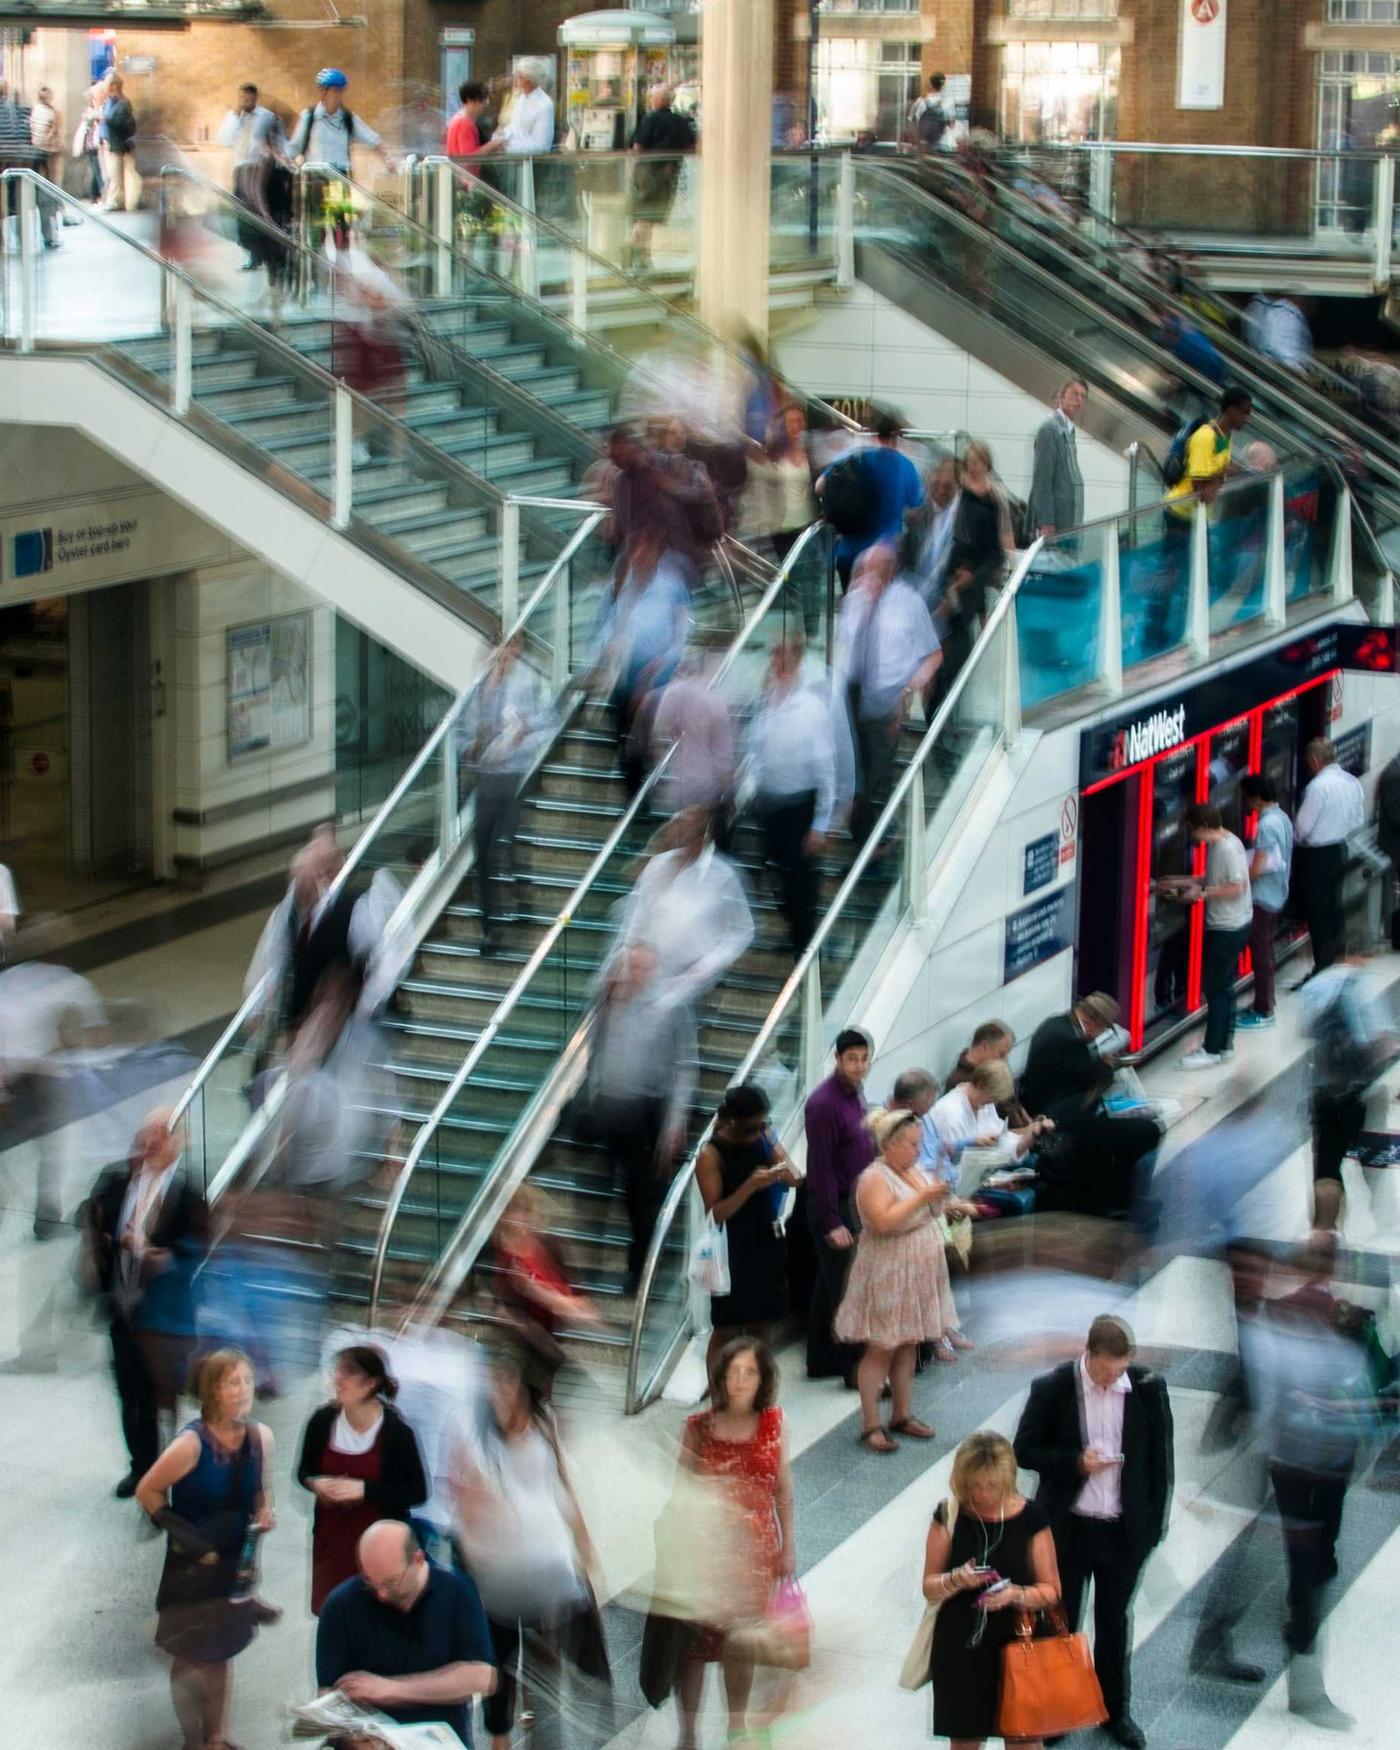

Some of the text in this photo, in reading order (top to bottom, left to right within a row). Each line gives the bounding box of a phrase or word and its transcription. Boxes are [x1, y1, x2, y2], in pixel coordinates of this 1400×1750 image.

[58, 544, 88, 564] Oyster
[89, 539, 110, 555] card
[1129, 703, 1186, 764] NatWest
